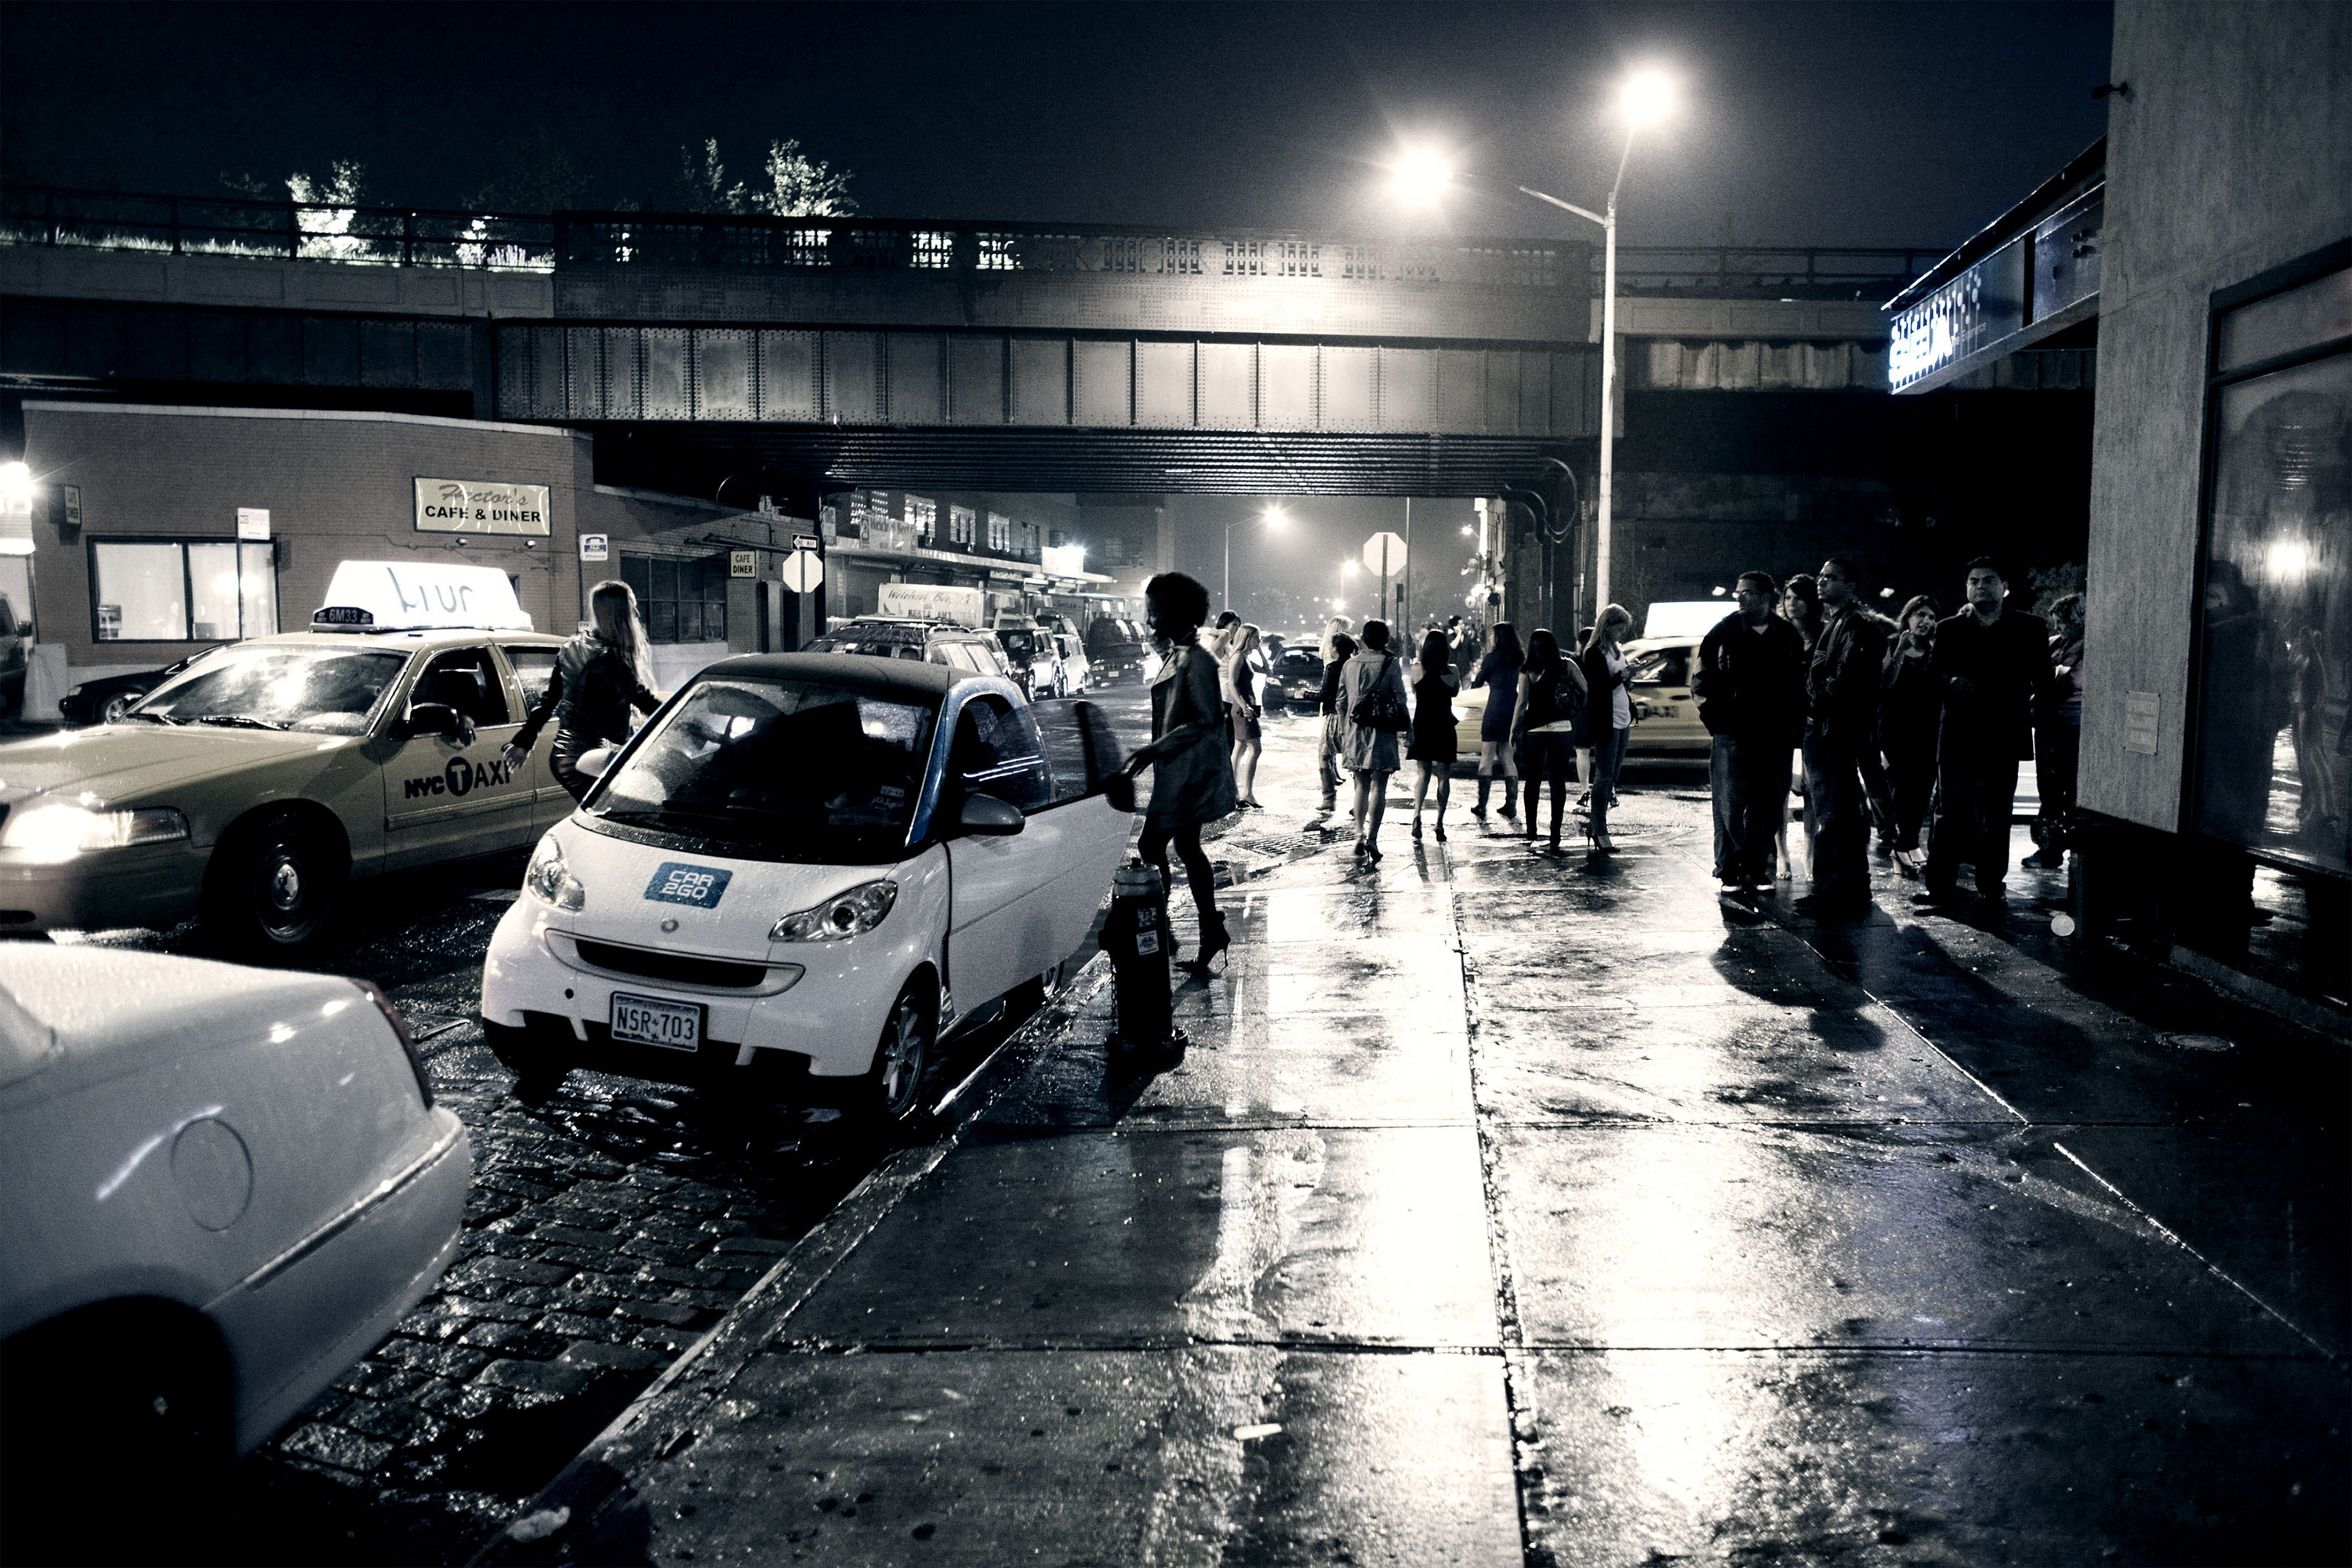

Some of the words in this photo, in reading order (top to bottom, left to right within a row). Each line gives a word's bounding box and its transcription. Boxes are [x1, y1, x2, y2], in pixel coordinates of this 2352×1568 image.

[425, 506, 469, 519] CAFE
[475, 509, 485, 520] &
[492, 510, 541, 522] DINER
[735, 554, 750, 563] CAFE
[733, 565, 753, 574] DINER
[329, 608, 358, 623] 6M33
[405, 776, 445, 799] NYC
[447, 757, 510, 795] TAXI
[669, 870, 714, 887] CAR
[660, 883, 708, 898] 2GO
